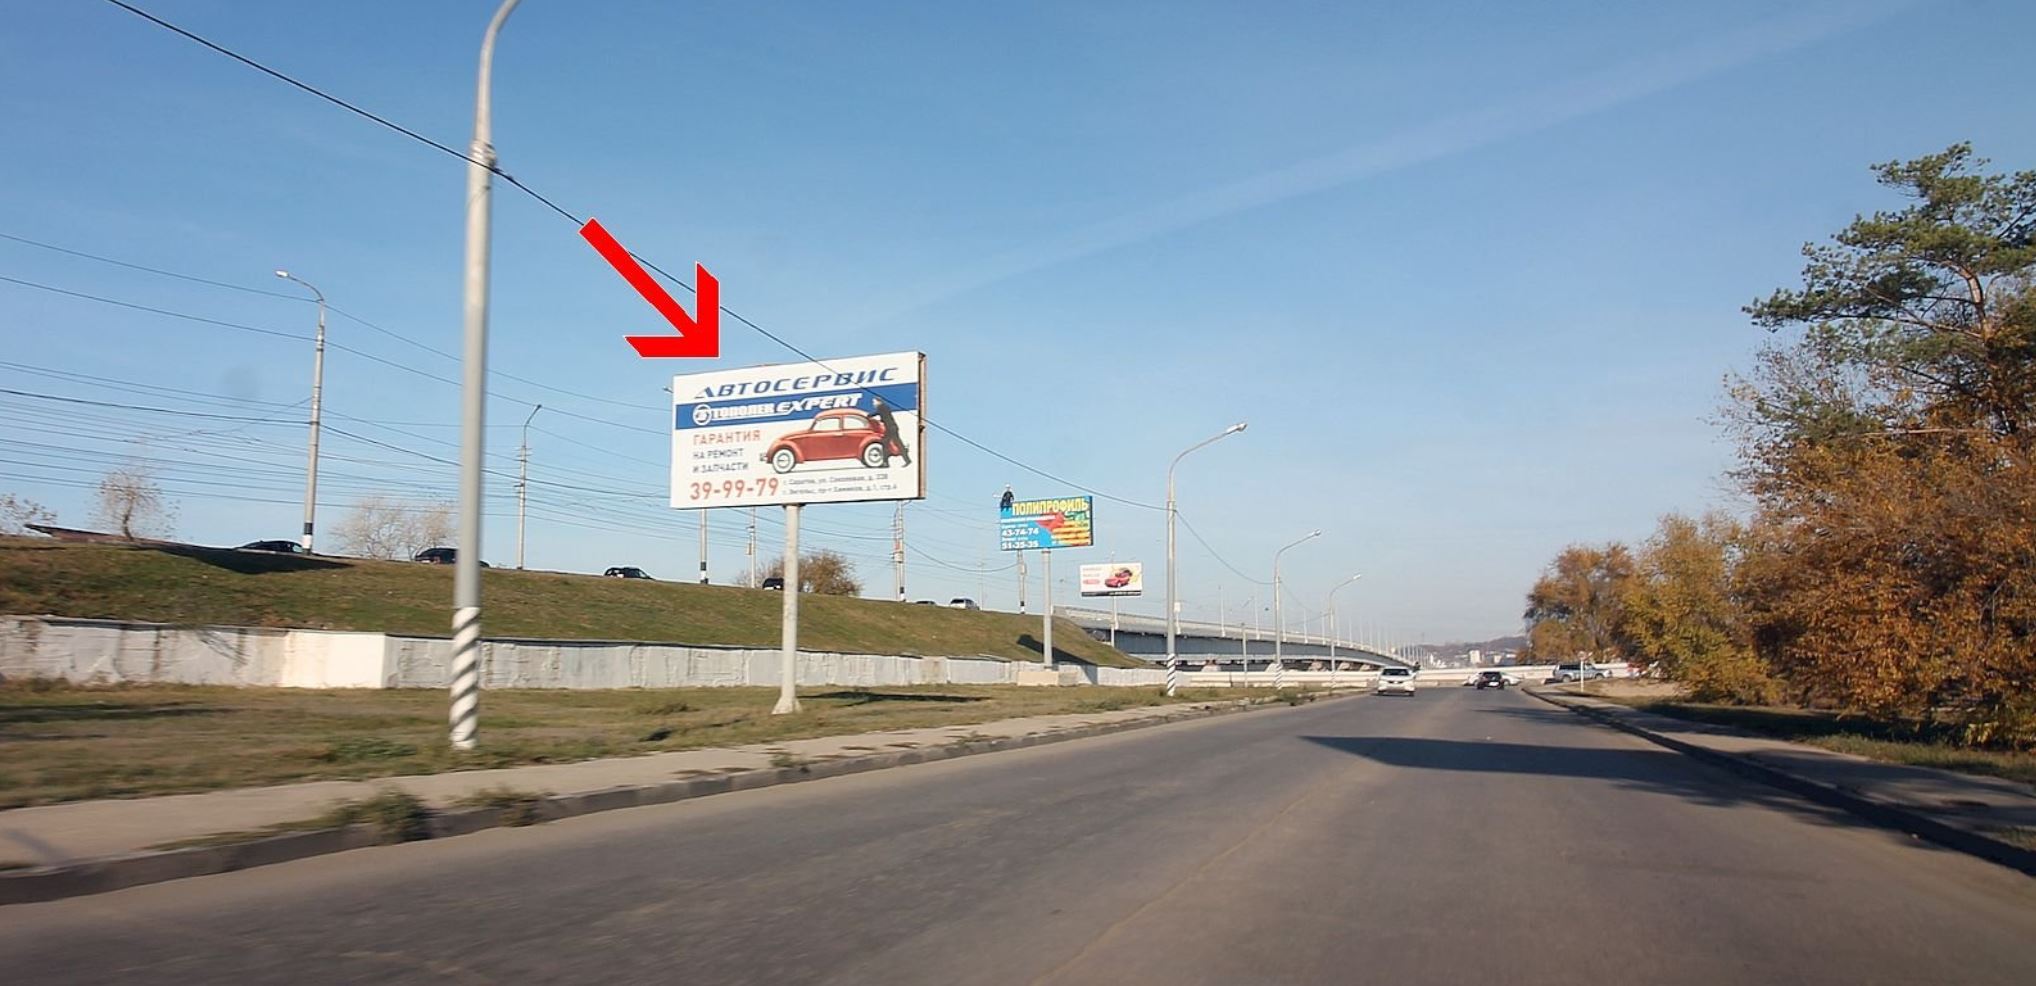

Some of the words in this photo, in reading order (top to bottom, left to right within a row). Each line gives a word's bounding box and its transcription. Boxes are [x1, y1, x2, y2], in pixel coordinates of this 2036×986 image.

[694, 367, 898, 399] АВТОСЕРВИС
[776, 393, 863, 414] EXPERT
[693, 430, 761, 446] ГАРАНТИЯ
[707, 447, 745, 459] РЕМОНТ
[689, 477, 779, 500] 39-99-79
[1012, 498, 1089, 516] ПОЛИПРОФИЛЬ
